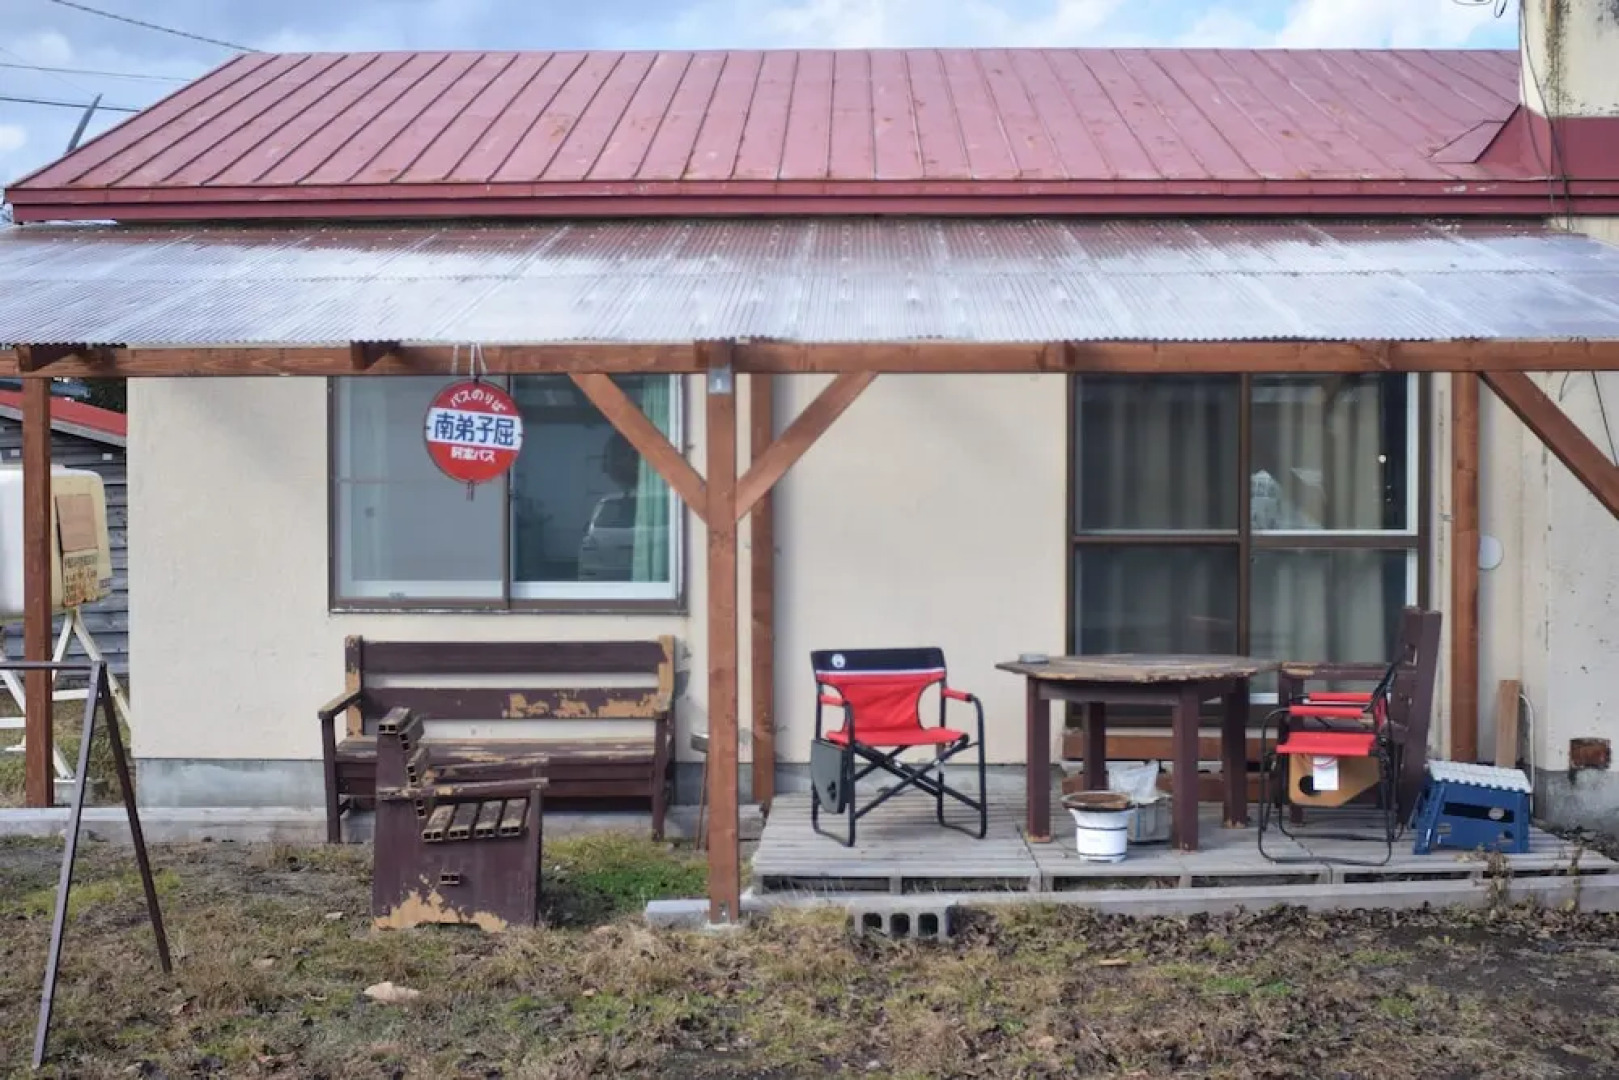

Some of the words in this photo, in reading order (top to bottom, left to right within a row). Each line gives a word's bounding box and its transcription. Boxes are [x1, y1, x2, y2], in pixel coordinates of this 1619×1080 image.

[451, 389, 506, 411] バスのりば
[434, 412, 514, 446] 南弟子屈
